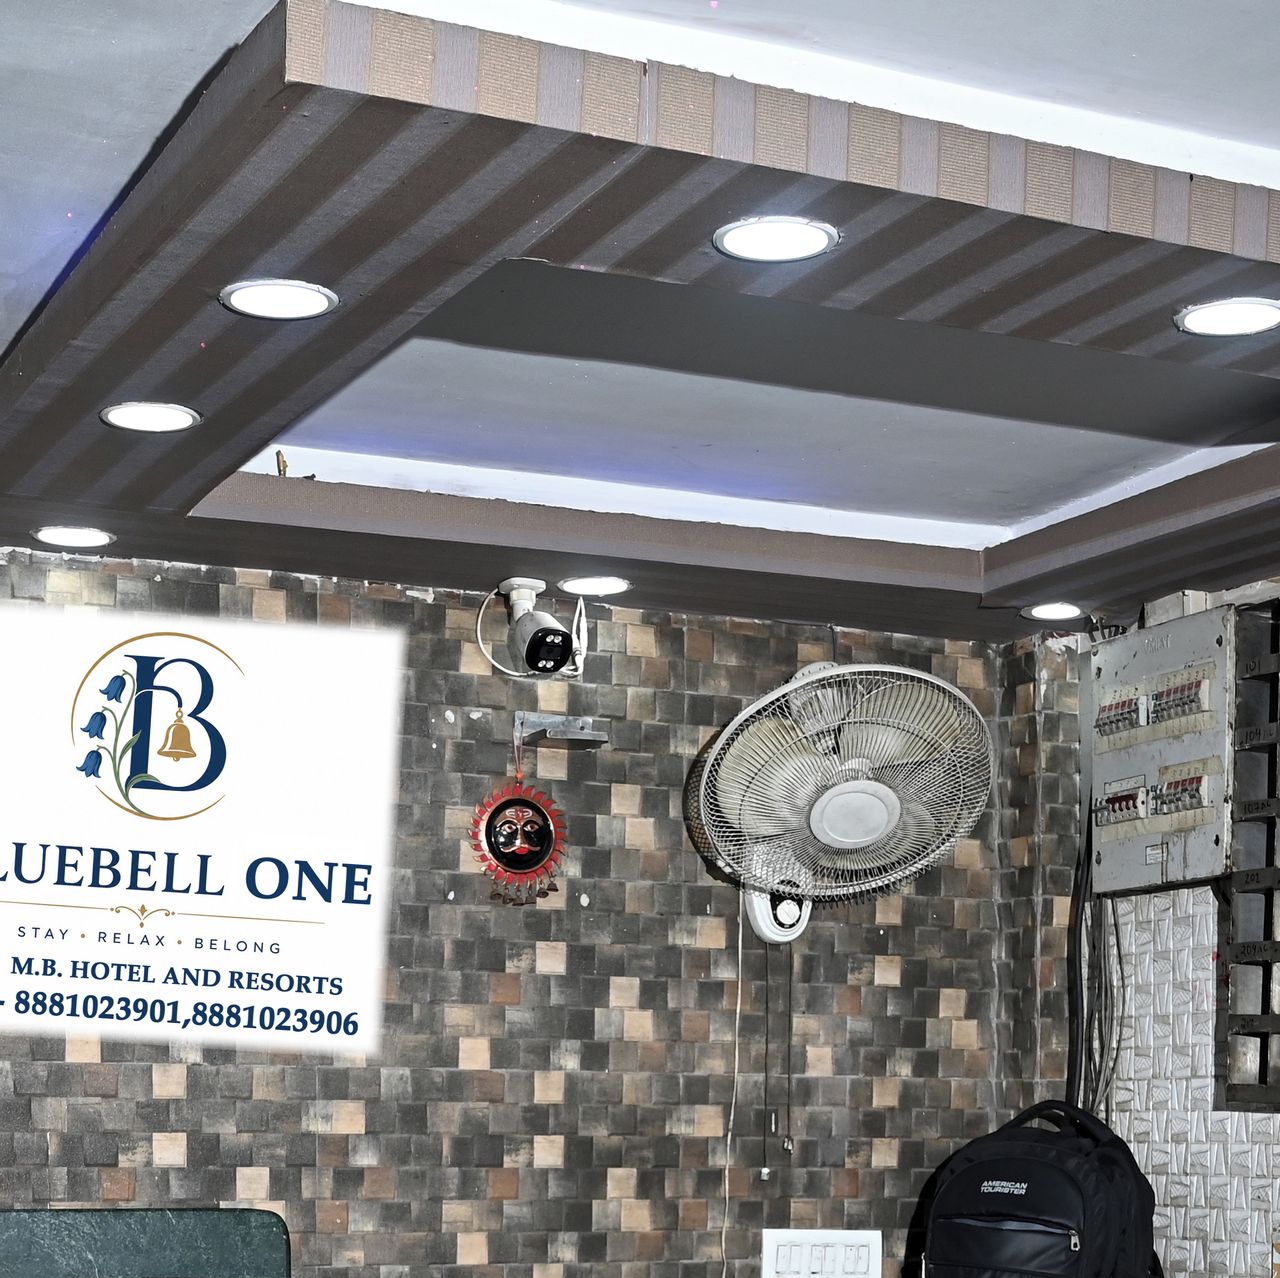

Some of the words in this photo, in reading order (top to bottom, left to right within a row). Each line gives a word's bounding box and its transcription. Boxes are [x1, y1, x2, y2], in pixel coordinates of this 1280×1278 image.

[124, 655, 227, 791] B
[246, 856, 373, 905] ONE
[17, 926, 69, 940] STAY
[98, 931, 165, 946] RELAX
[194, 937, 280, 954] BELONG
[10, 956, 63, 978] M.B.
[70, 960, 156, 983] HOTEL
[162, 966, 221, 987] AND
[228, 970, 343, 995] RESORTS
[980, 1186, 1026, 1195] TOURISTER
[982, 1180, 1028, 1189] AMERICAN
